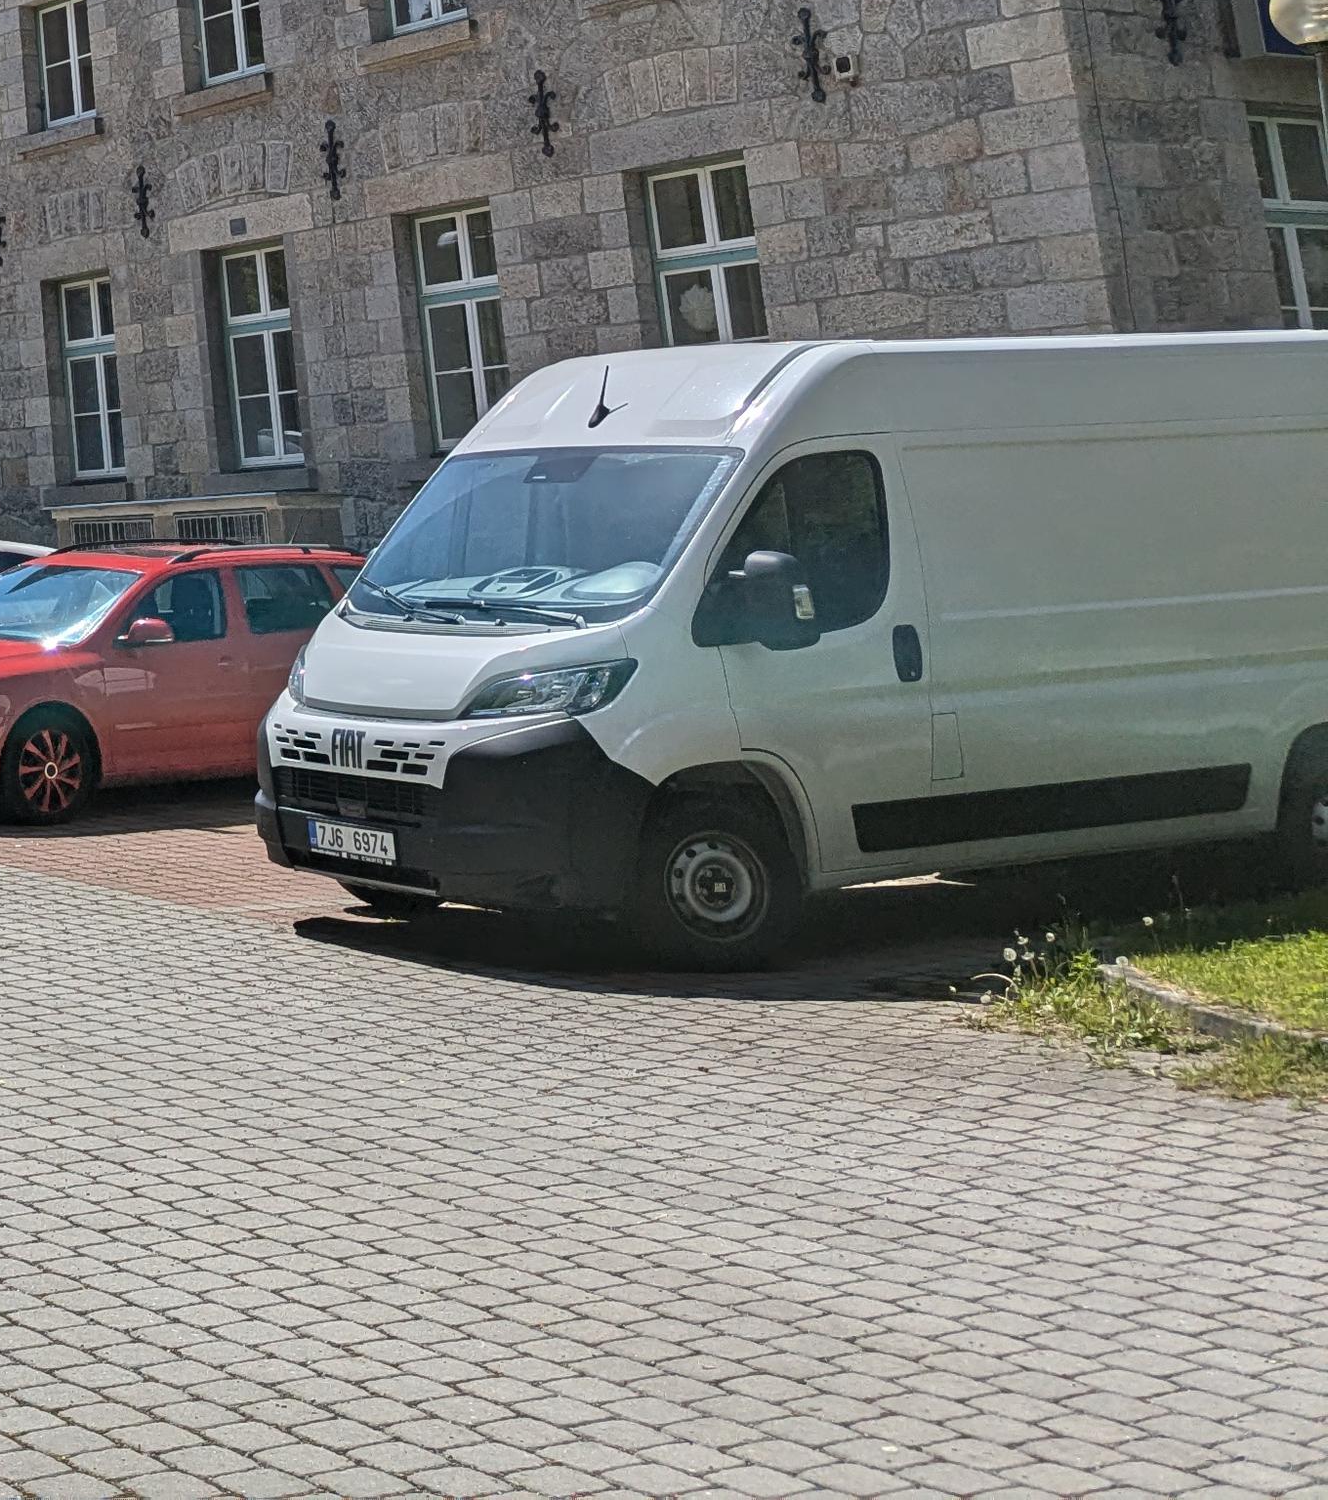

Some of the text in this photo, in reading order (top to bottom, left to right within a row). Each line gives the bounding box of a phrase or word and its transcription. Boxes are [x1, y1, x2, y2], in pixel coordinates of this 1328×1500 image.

[331, 728, 367, 769] FIAT
[318, 825, 388, 855] 7J6 6974
